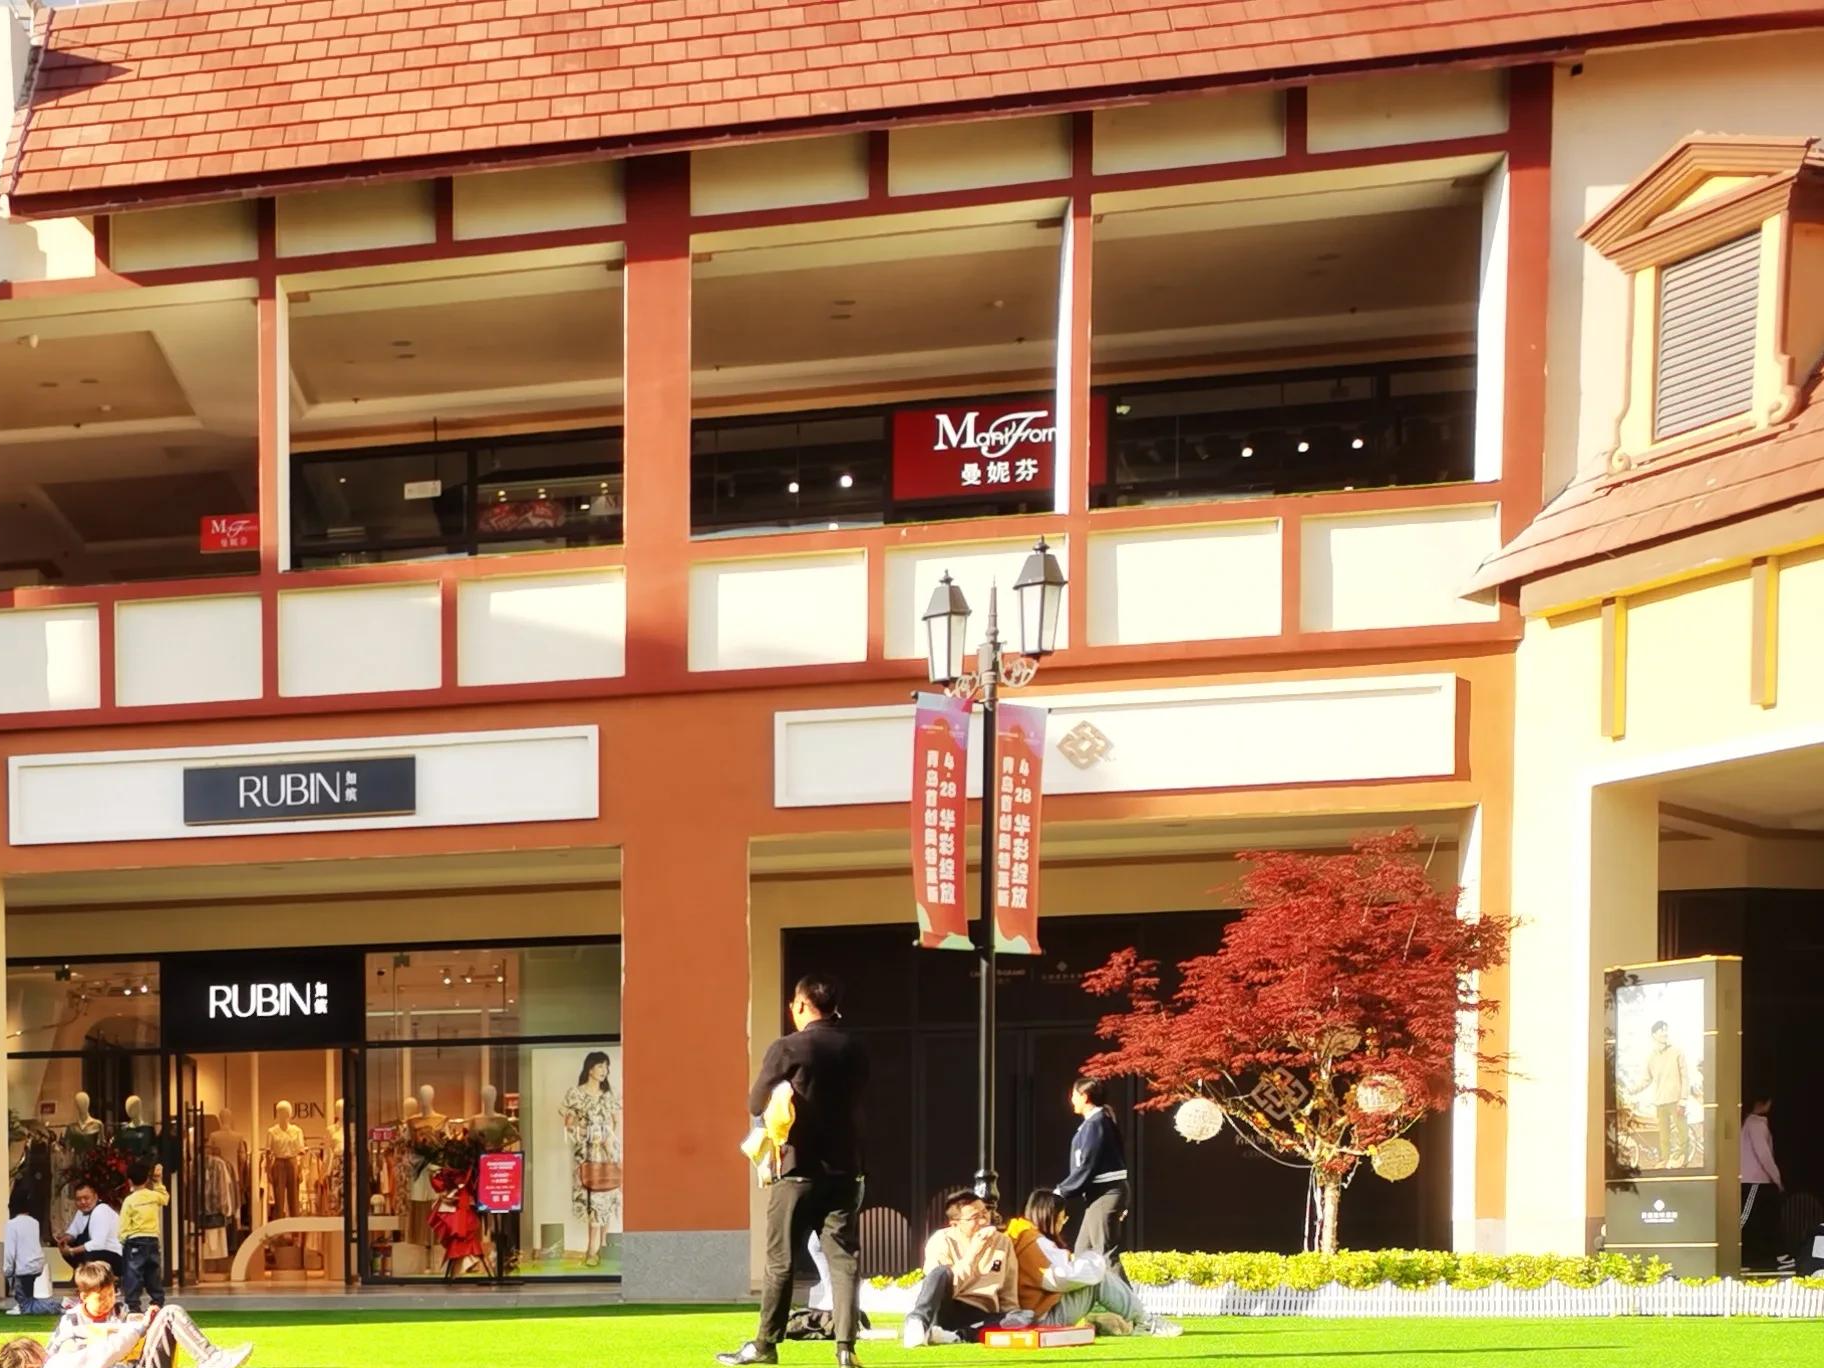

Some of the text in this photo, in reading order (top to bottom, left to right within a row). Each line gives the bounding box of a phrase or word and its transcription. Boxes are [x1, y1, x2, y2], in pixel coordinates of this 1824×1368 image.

[961, 458, 1038, 486] 曼妮芬
[239, 770, 341, 808] RUBIN
[208, 982, 311, 1019] RUBIN
